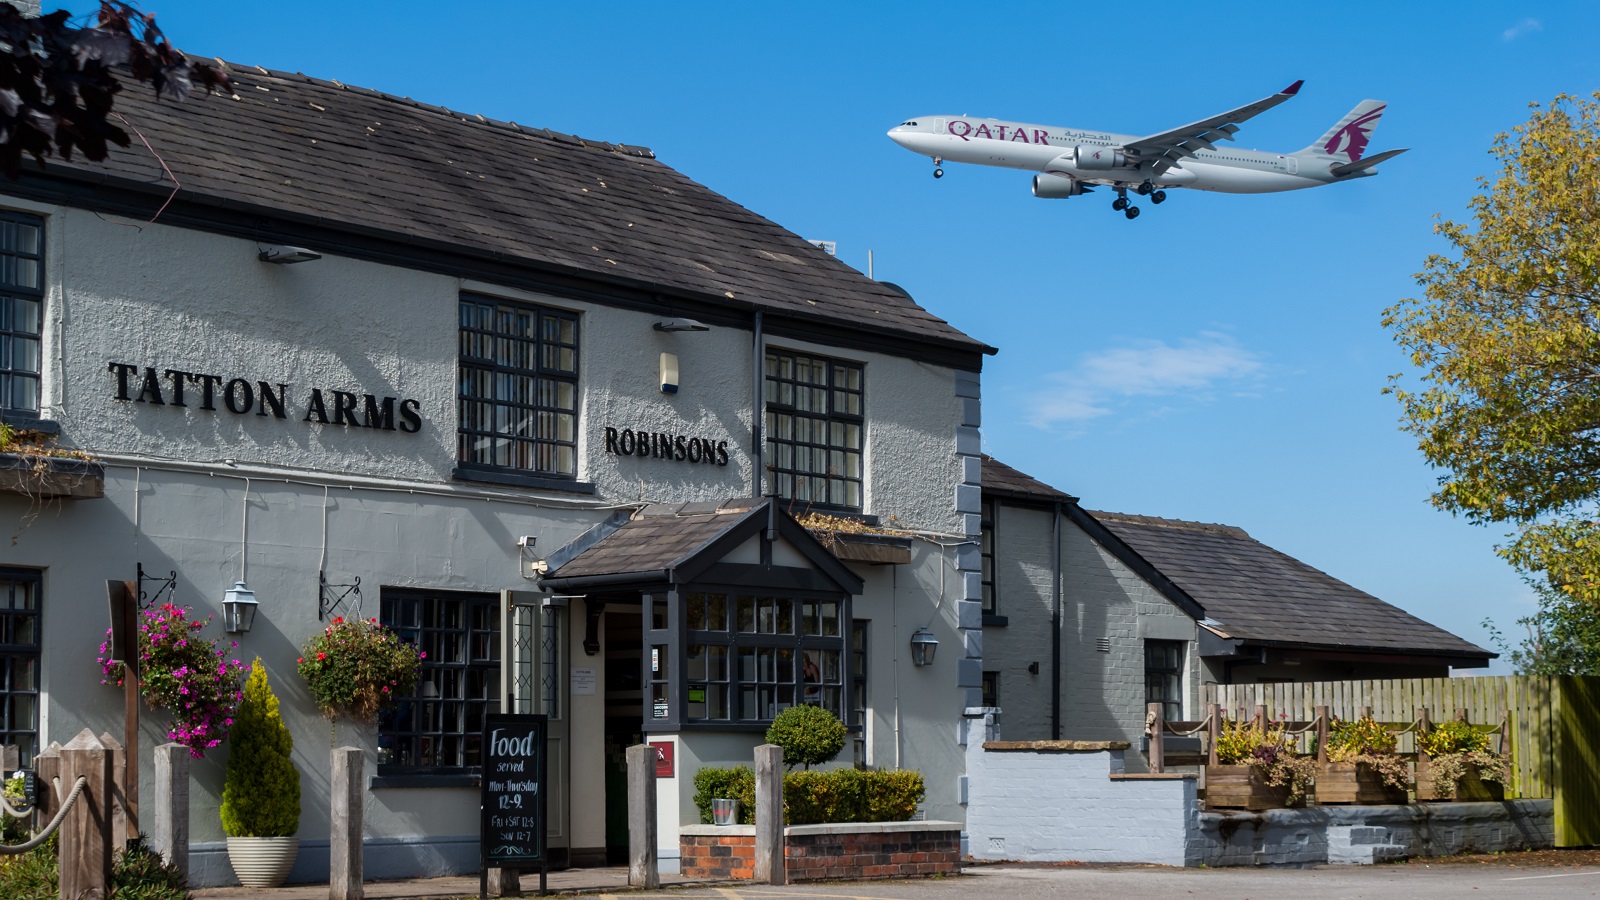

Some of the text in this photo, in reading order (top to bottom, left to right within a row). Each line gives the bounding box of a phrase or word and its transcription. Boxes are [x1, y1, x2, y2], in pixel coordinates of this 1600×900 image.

[948, 120, 1050, 146] QATAR
[1064, 129, 1112, 141] القطرية
[108, 361, 422, 433] TATTON ARMS
[605, 426, 729, 466] ROBINSONS
[490, 728, 535, 757] Food
[496, 760, 525, 773] served
[522, 816, 534, 828] 12-8
[500, 831, 531, 842] SUN 12-7
